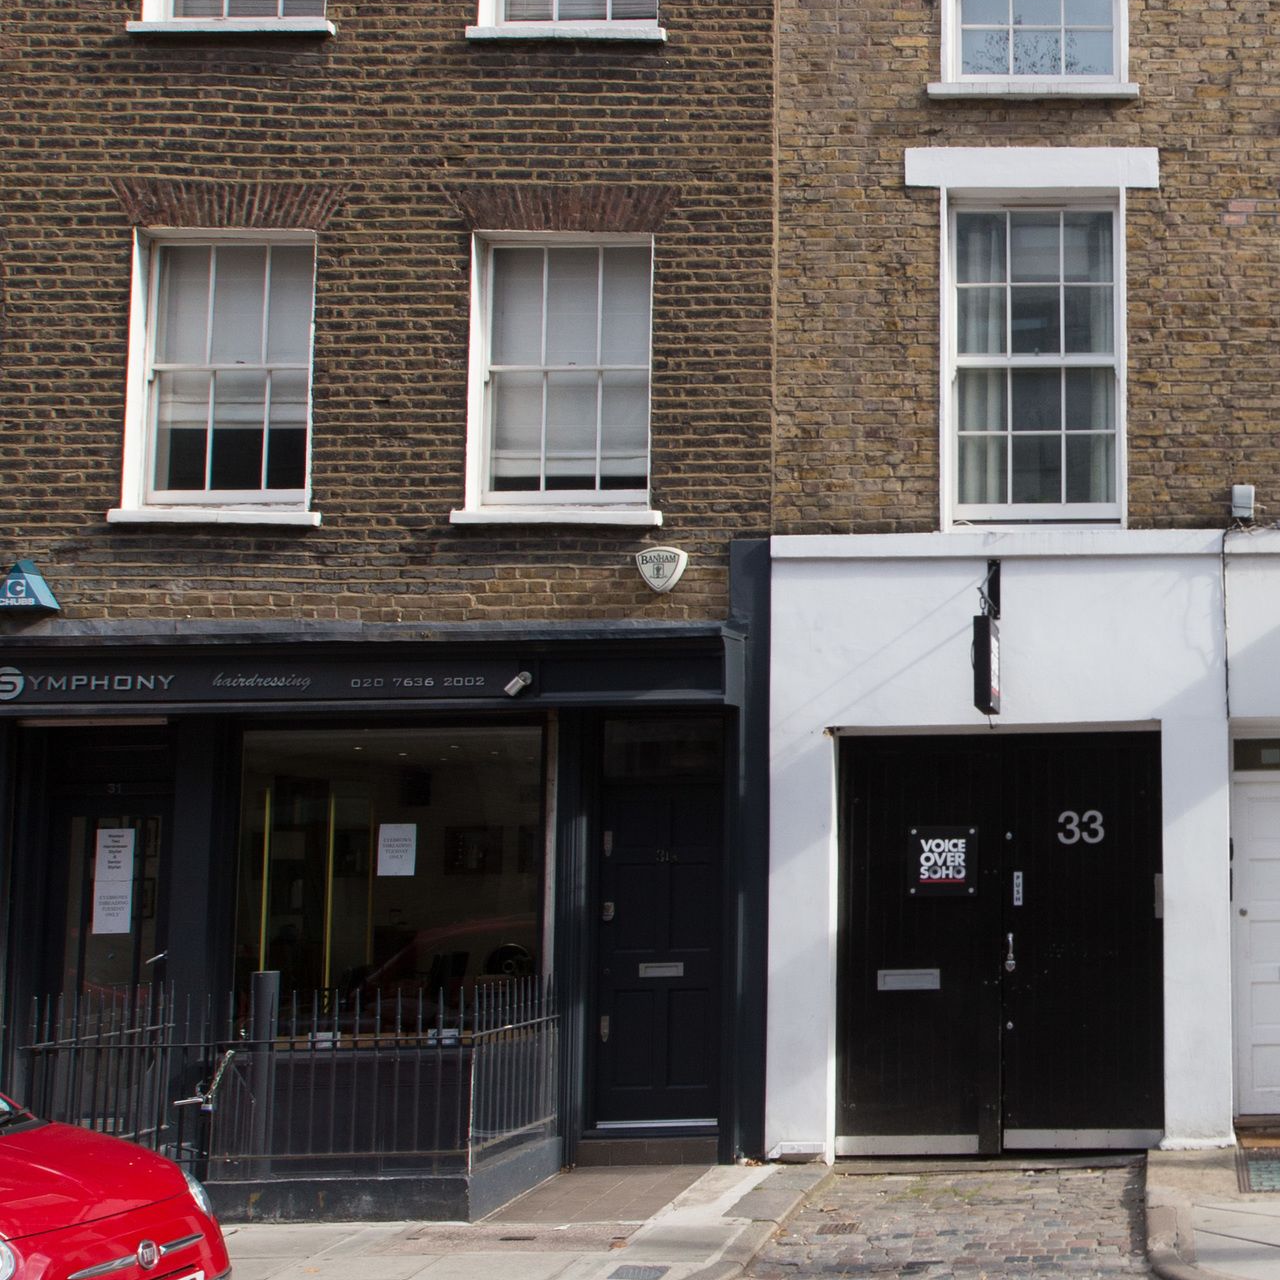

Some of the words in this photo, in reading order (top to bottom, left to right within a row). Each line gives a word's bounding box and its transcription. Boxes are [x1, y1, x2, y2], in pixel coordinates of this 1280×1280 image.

[641, 553, 676, 565] BANHAM
[212, 671, 311, 693] hairdressing
[351, 678, 384, 688] 020
[393, 677, 434, 687] 7636
[443, 676, 485, 686] 2002
[1057, 810, 1105, 845] 33
[920, 839, 966, 852] VOICE
[919, 852, 966, 866] OVER
[919, 866, 966, 879] SOHO
